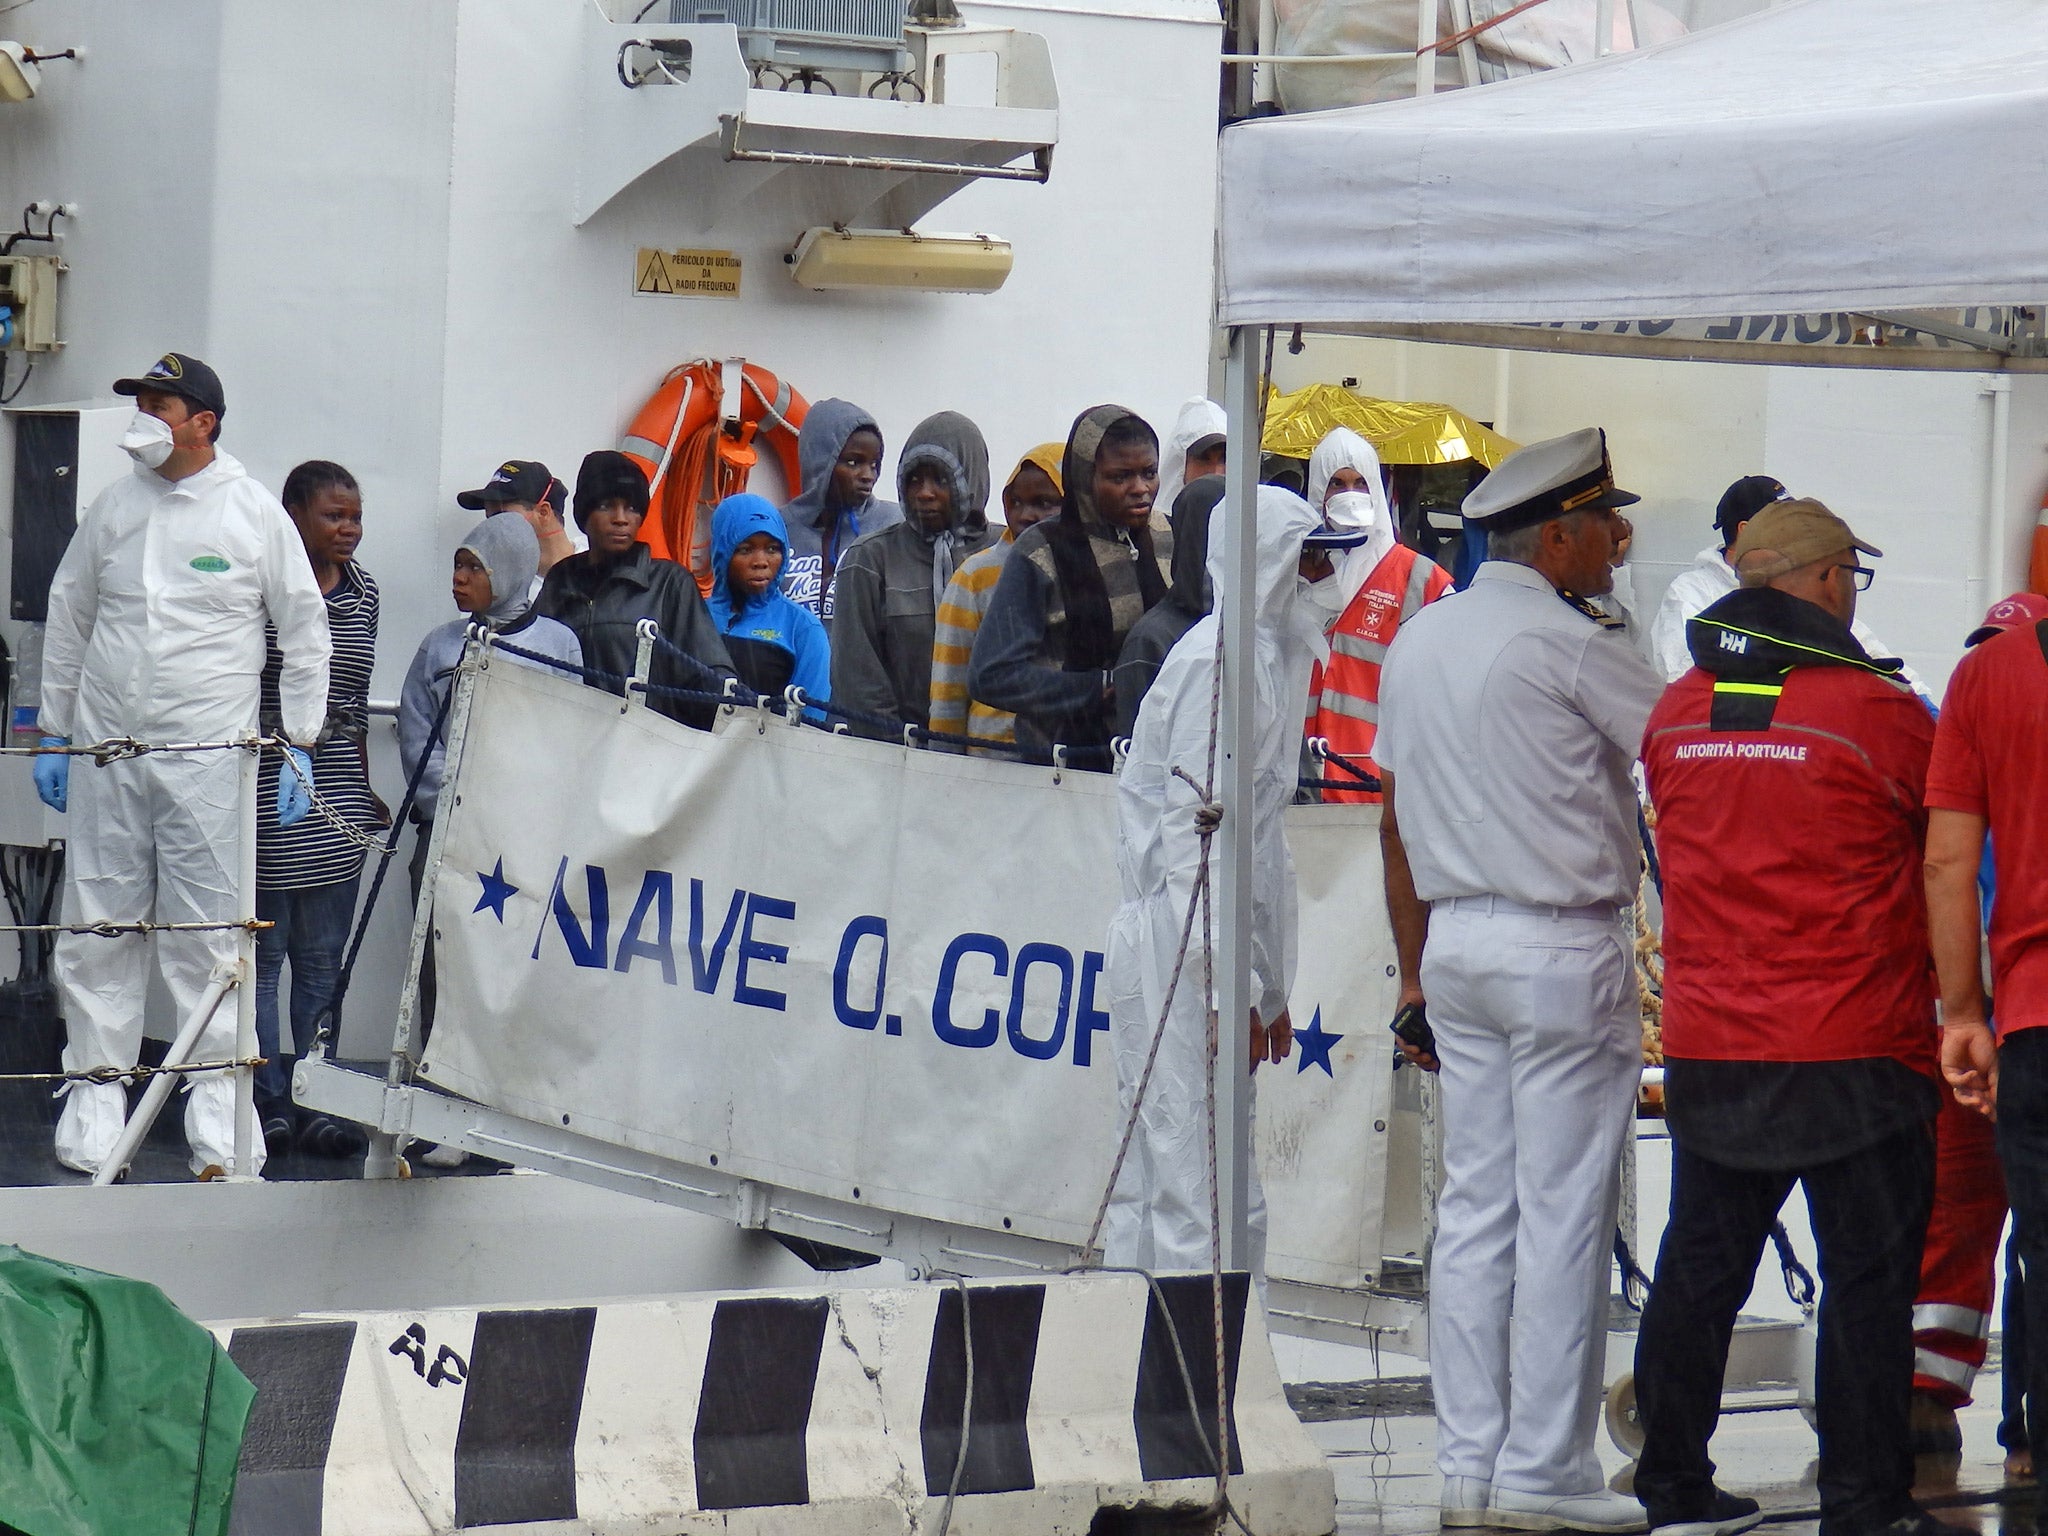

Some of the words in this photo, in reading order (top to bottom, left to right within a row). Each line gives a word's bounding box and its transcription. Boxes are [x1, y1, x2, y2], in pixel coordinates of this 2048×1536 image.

[672, 255, 704, 265] PERICOLO
[706, 256, 714, 267] DI
[702, 268, 711, 278] DA
[675, 279, 697, 290] RADIO
[698, 280, 736, 292] FREQUENZA
[1383, 598, 1399, 608] MALTA
[1719, 630, 1748, 655] HH
[1674, 740, 1734, 760] AUTORITÀ
[1736, 743, 1808, 761] PORTUALE
[530, 854, 797, 1012] NAVE
[832, 914, 902, 1037] O.
